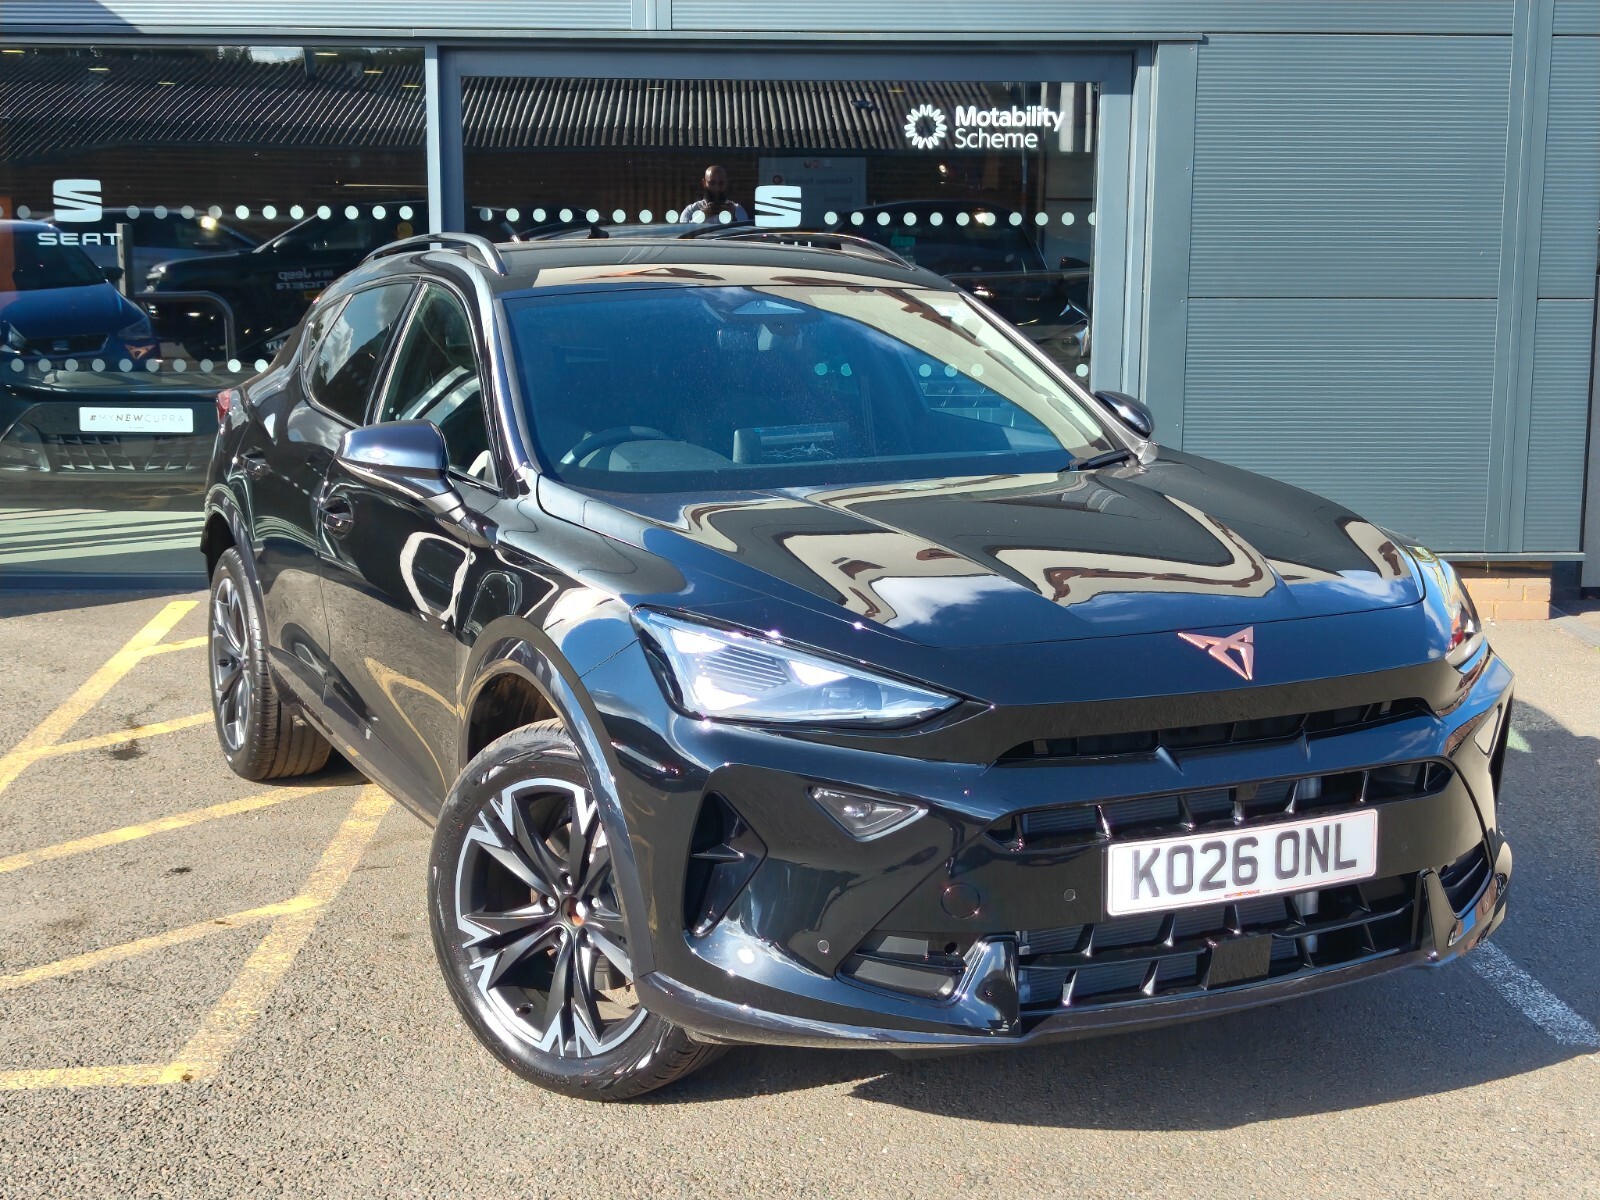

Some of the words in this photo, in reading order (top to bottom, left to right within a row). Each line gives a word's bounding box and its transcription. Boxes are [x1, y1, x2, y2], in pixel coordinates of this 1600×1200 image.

[955, 105, 1066, 132] Motability
[955, 128, 1038, 149] Scheme
[37, 232, 121, 246] SEAT
[1131, 836, 1259, 900] KO26
[1274, 822, 1357, 880] ONL
